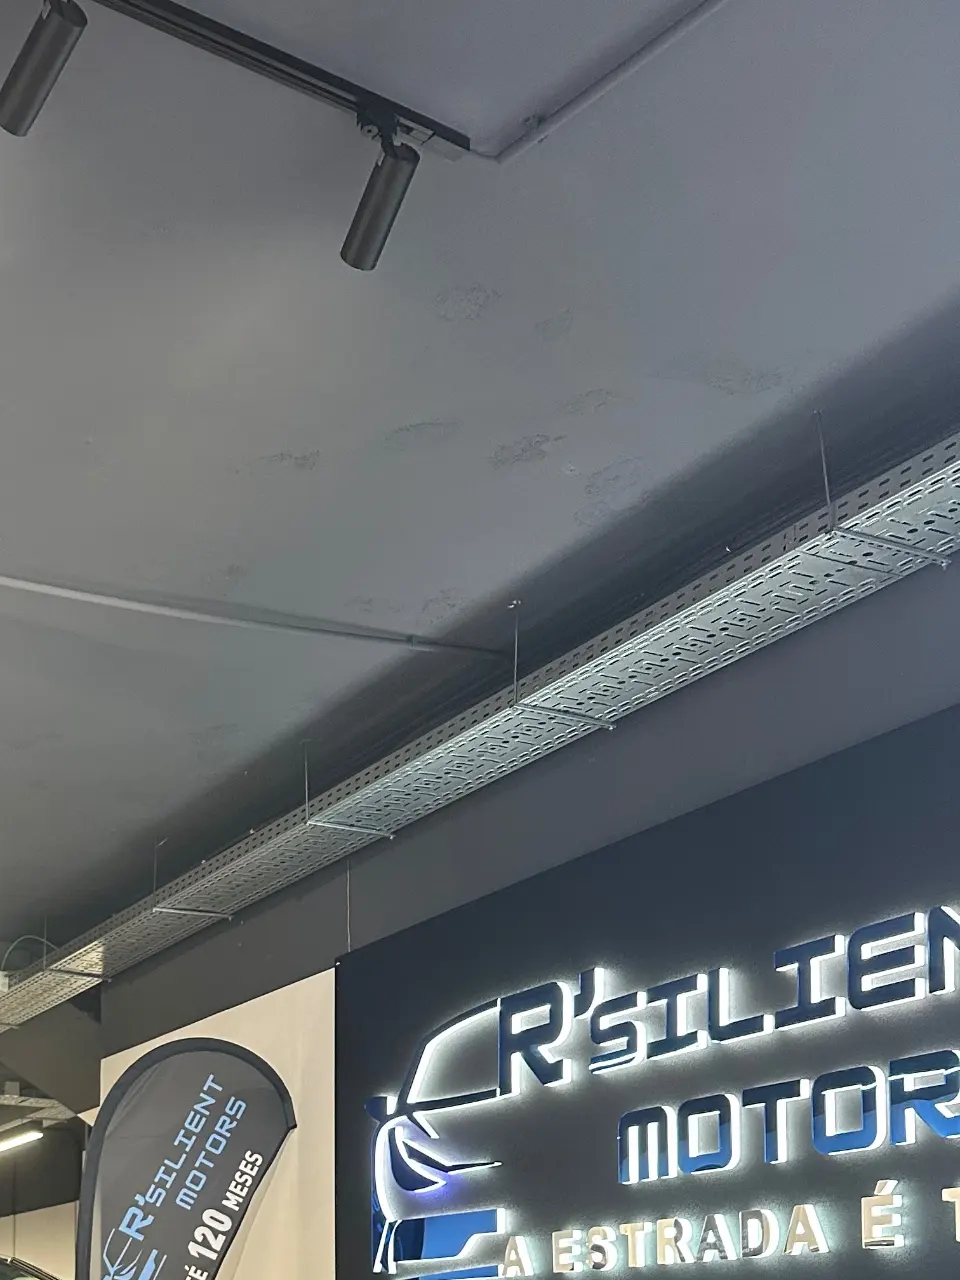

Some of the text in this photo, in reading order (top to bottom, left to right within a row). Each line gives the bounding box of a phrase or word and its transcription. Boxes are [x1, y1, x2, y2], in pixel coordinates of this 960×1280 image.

[118, 1073, 224, 1242] R'SILIENT
[175, 1096, 248, 1211] MOTORS
[187, 1208, 233, 1261] 120
[221, 1149, 264, 1212] MESES
[501, 1235, 534, 1278] A
[551, 1203, 830, 1274] ESTRADA
[861, 1178, 905, 1249] É
